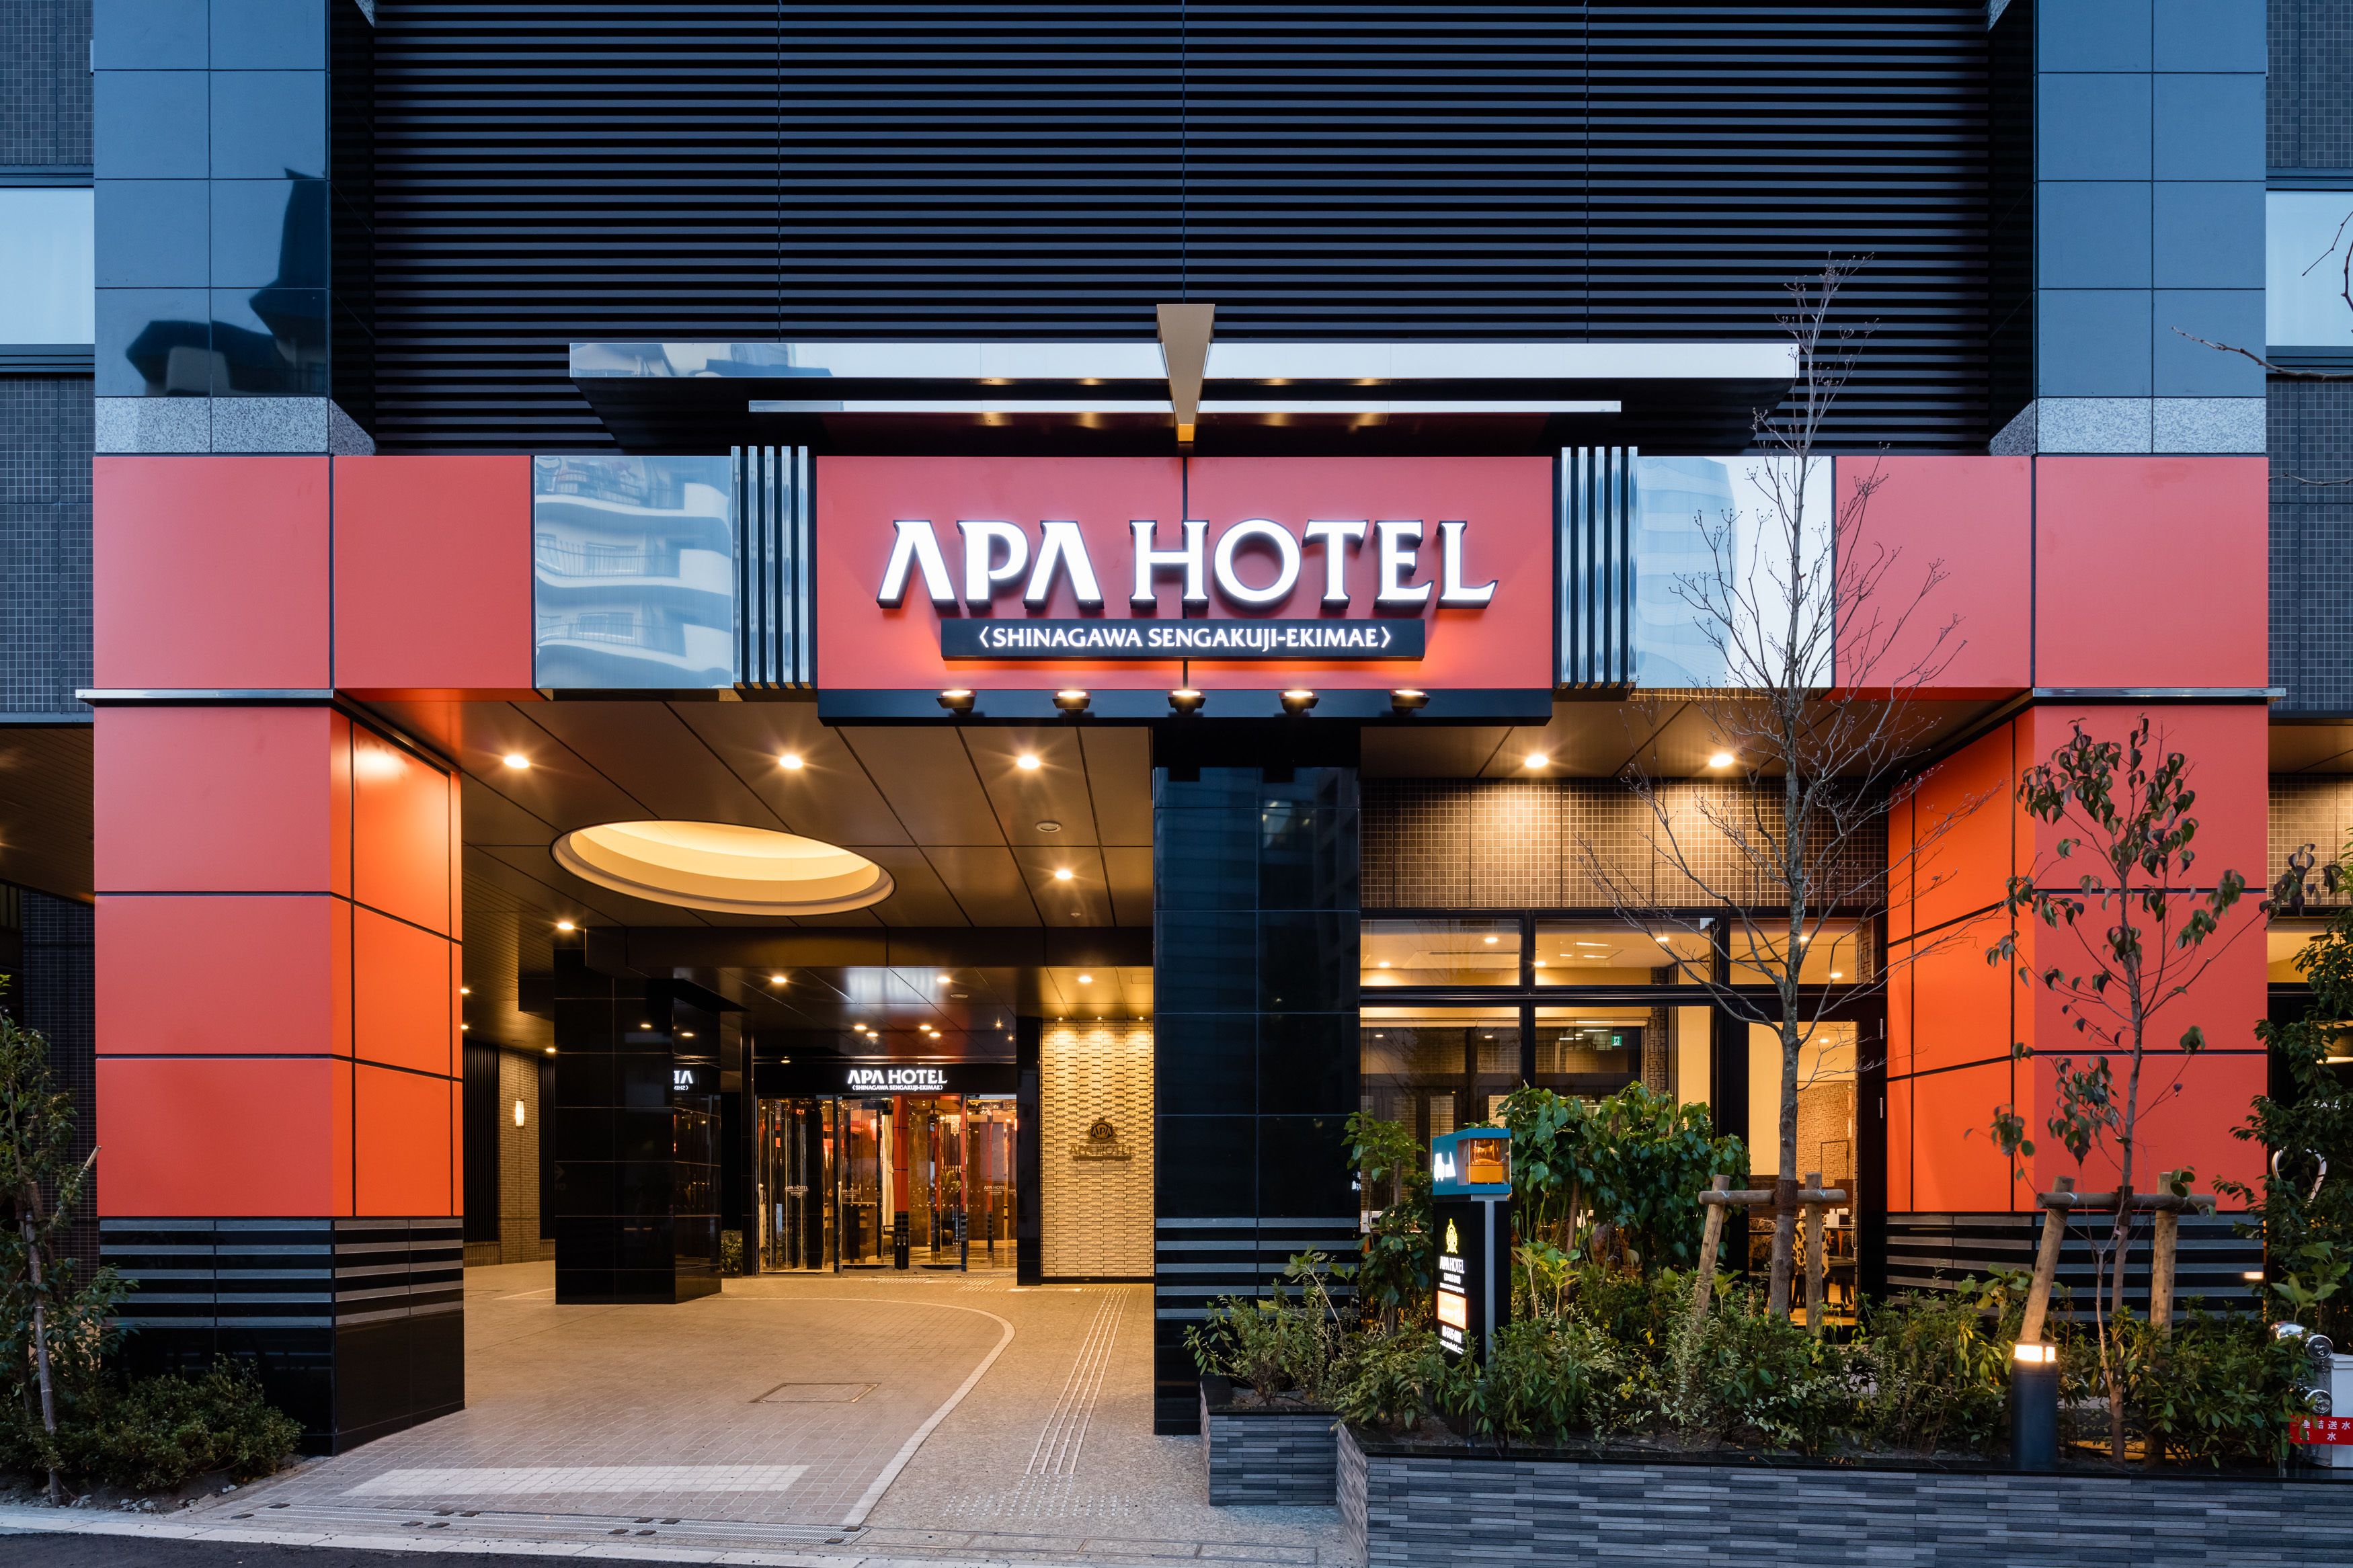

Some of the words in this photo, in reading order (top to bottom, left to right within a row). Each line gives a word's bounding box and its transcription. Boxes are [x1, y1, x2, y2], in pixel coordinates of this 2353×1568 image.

[876, 520, 1104, 609] APA
[1129, 518, 1499, 610] HOTEL
[847, 1070, 885, 1084] APA
[887, 1069, 948, 1084] HOTEL
[1092, 1127, 1112, 1135] APA
[1070, 1145, 1092, 1155] APA
[1096, 1145, 1135, 1155] HOTEL
[1449, 1257, 1465, 1274] HOTEL
